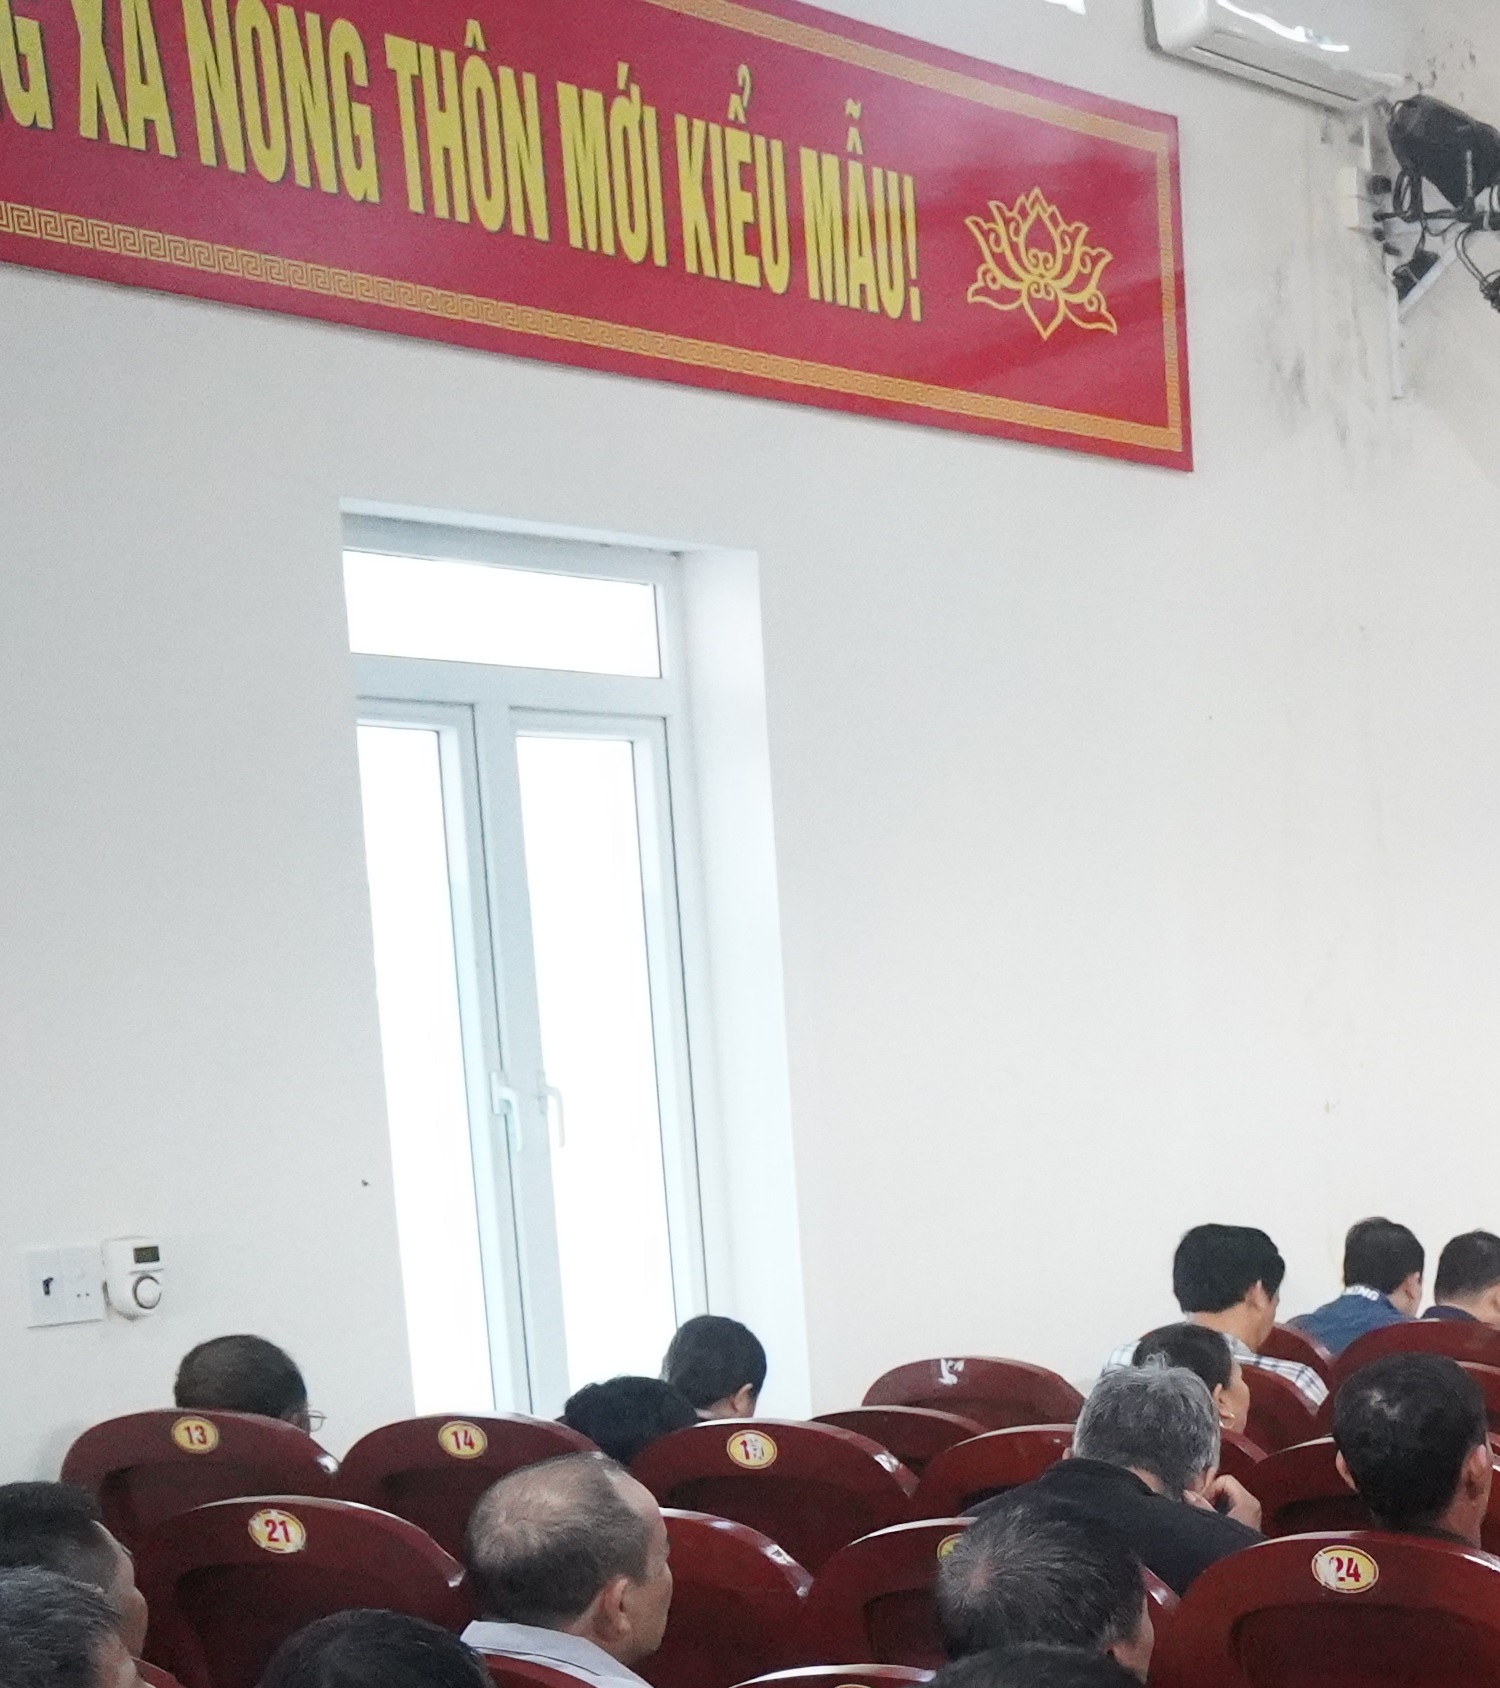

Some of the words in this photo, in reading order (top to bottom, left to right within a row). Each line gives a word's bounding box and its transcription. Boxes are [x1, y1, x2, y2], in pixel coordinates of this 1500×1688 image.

[384, 19, 549, 242] THÔN
[556, 61, 667, 268] MỚI
[675, 65, 790, 295] KIỂU
[800, 98, 921, 322] MẪU!
[184, 1423, 209, 1447] 13
[450, 1428, 476, 1452] 14
[265, 1518, 291, 1544] 21
